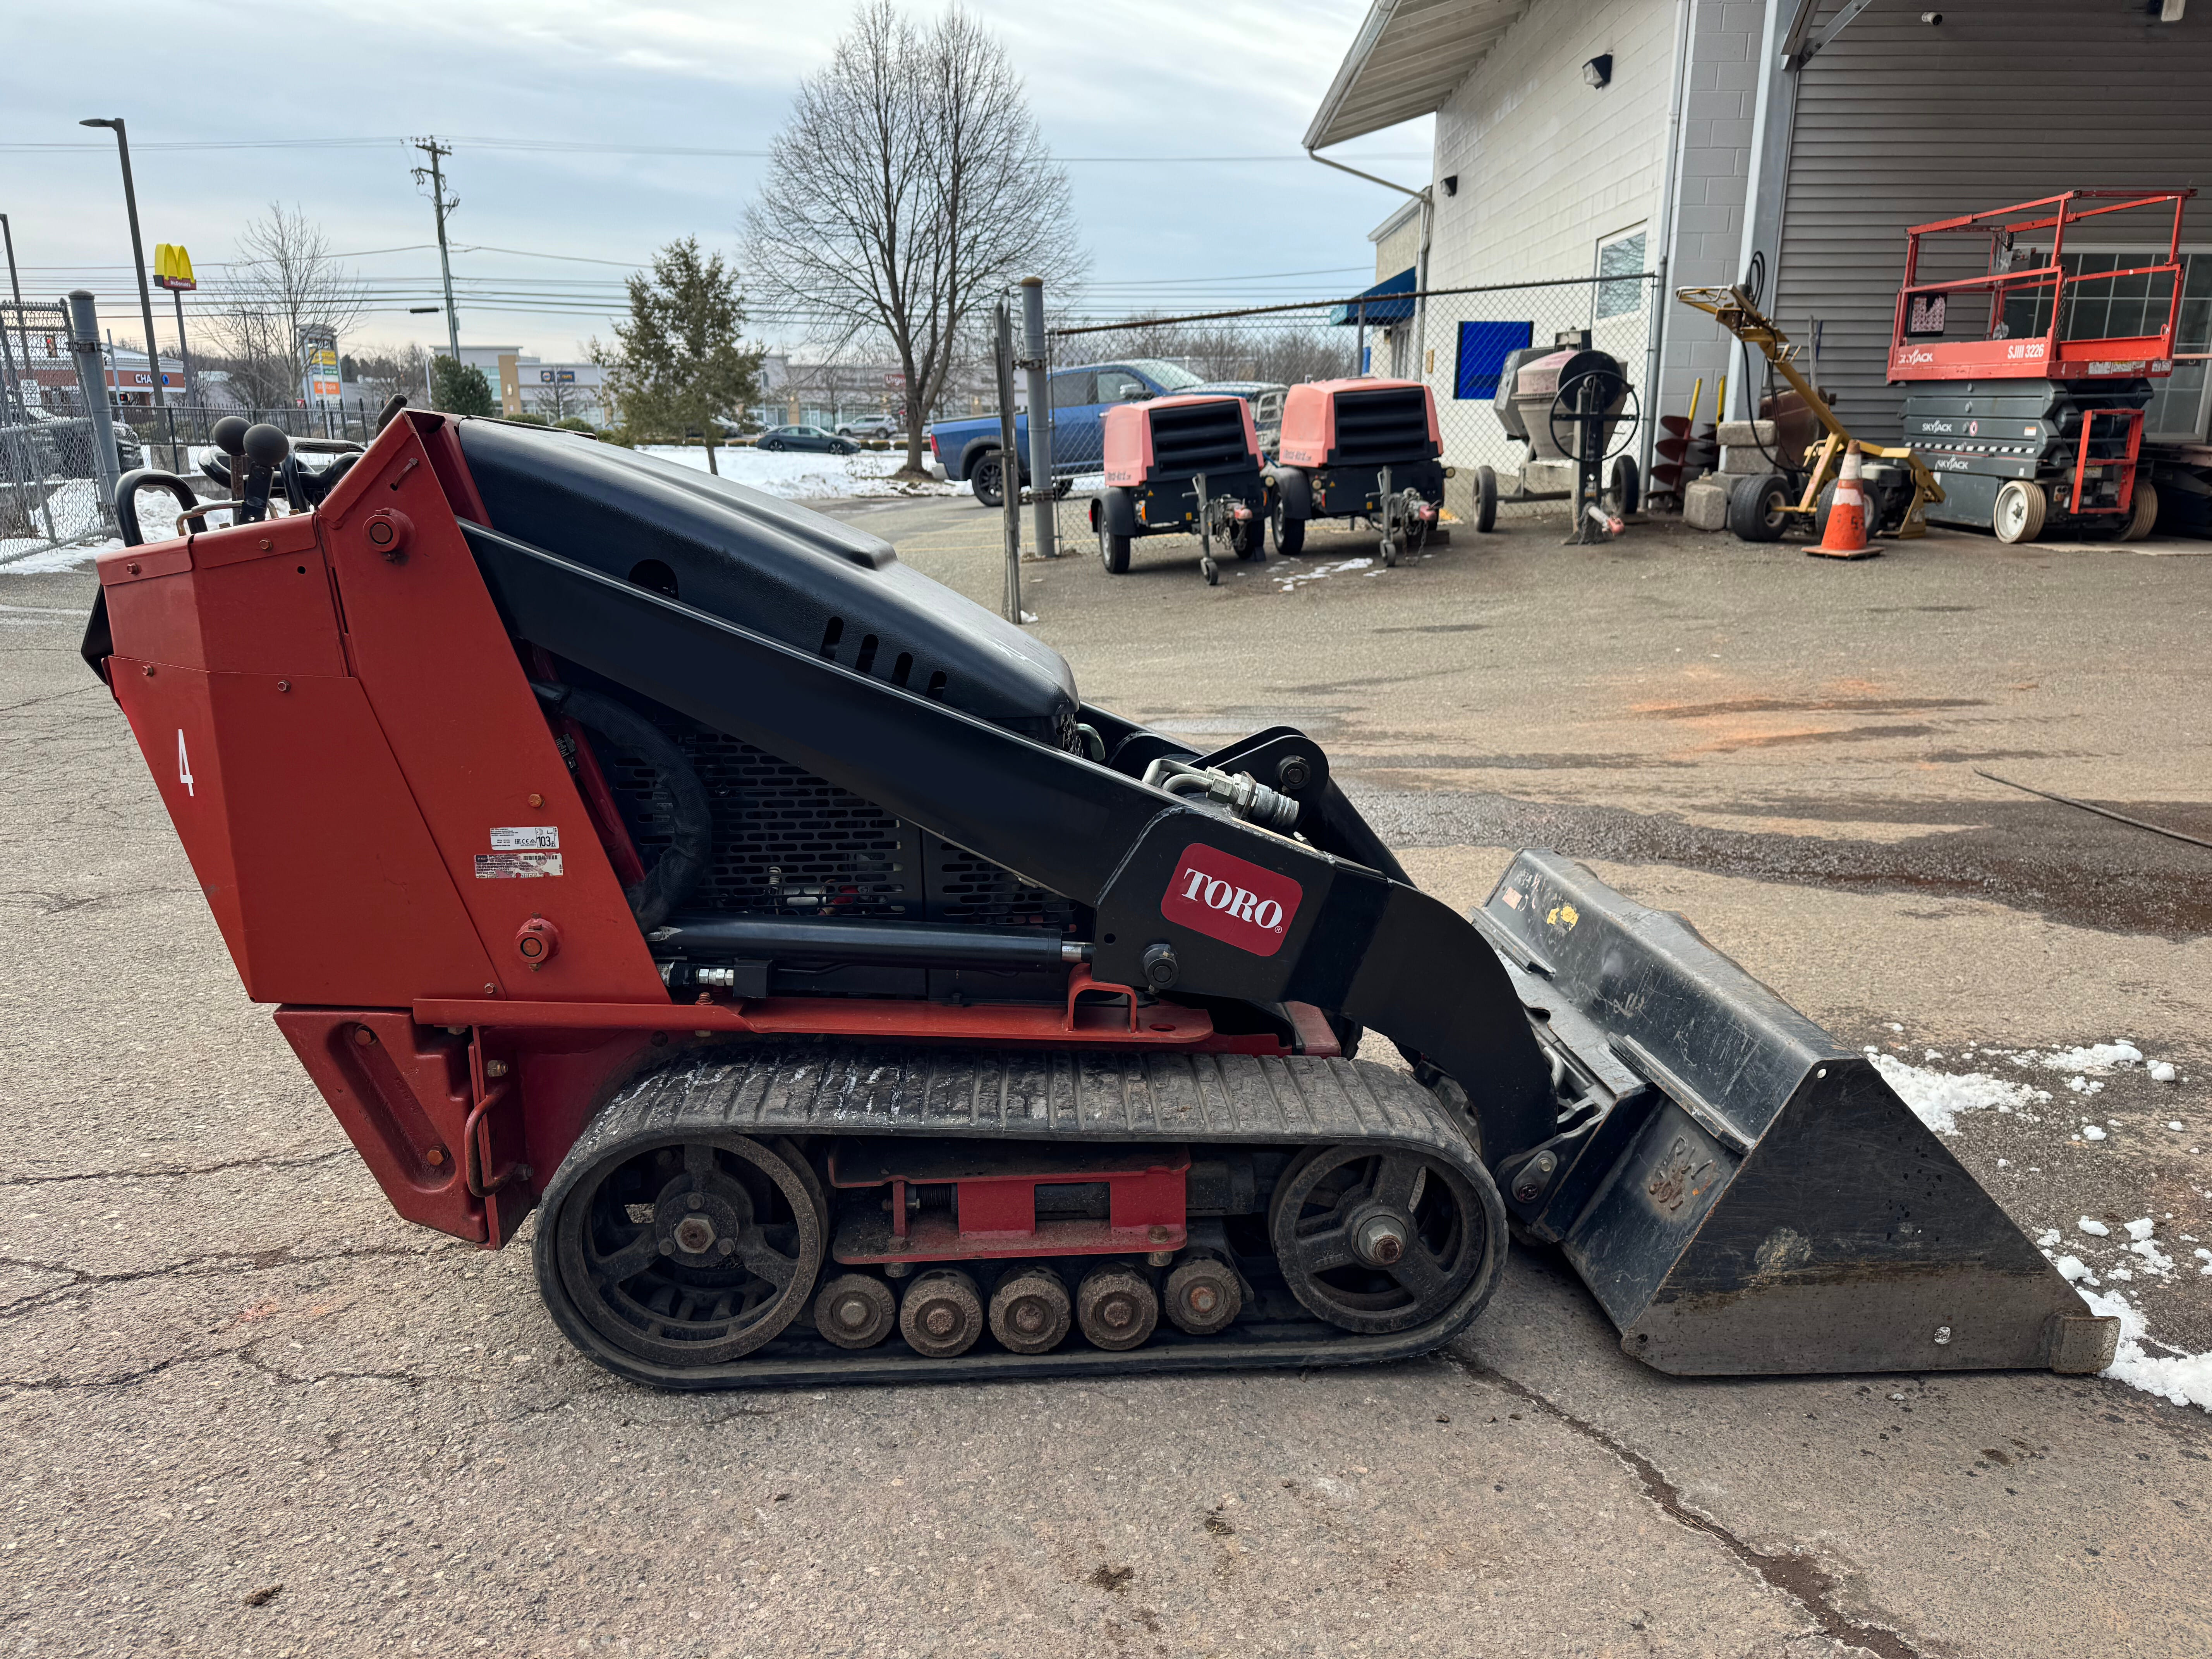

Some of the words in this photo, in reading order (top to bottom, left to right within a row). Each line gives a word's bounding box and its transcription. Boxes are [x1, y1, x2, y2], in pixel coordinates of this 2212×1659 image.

[2025, 343, 2044, 358] 3226
[135, 374, 153, 384] CHA
[1922, 419, 1952, 433] SKYJACK
[1935, 454, 1968, 471] SKYJACK
[178, 729, 194, 797] 4
[537, 836, 551, 847] 103
